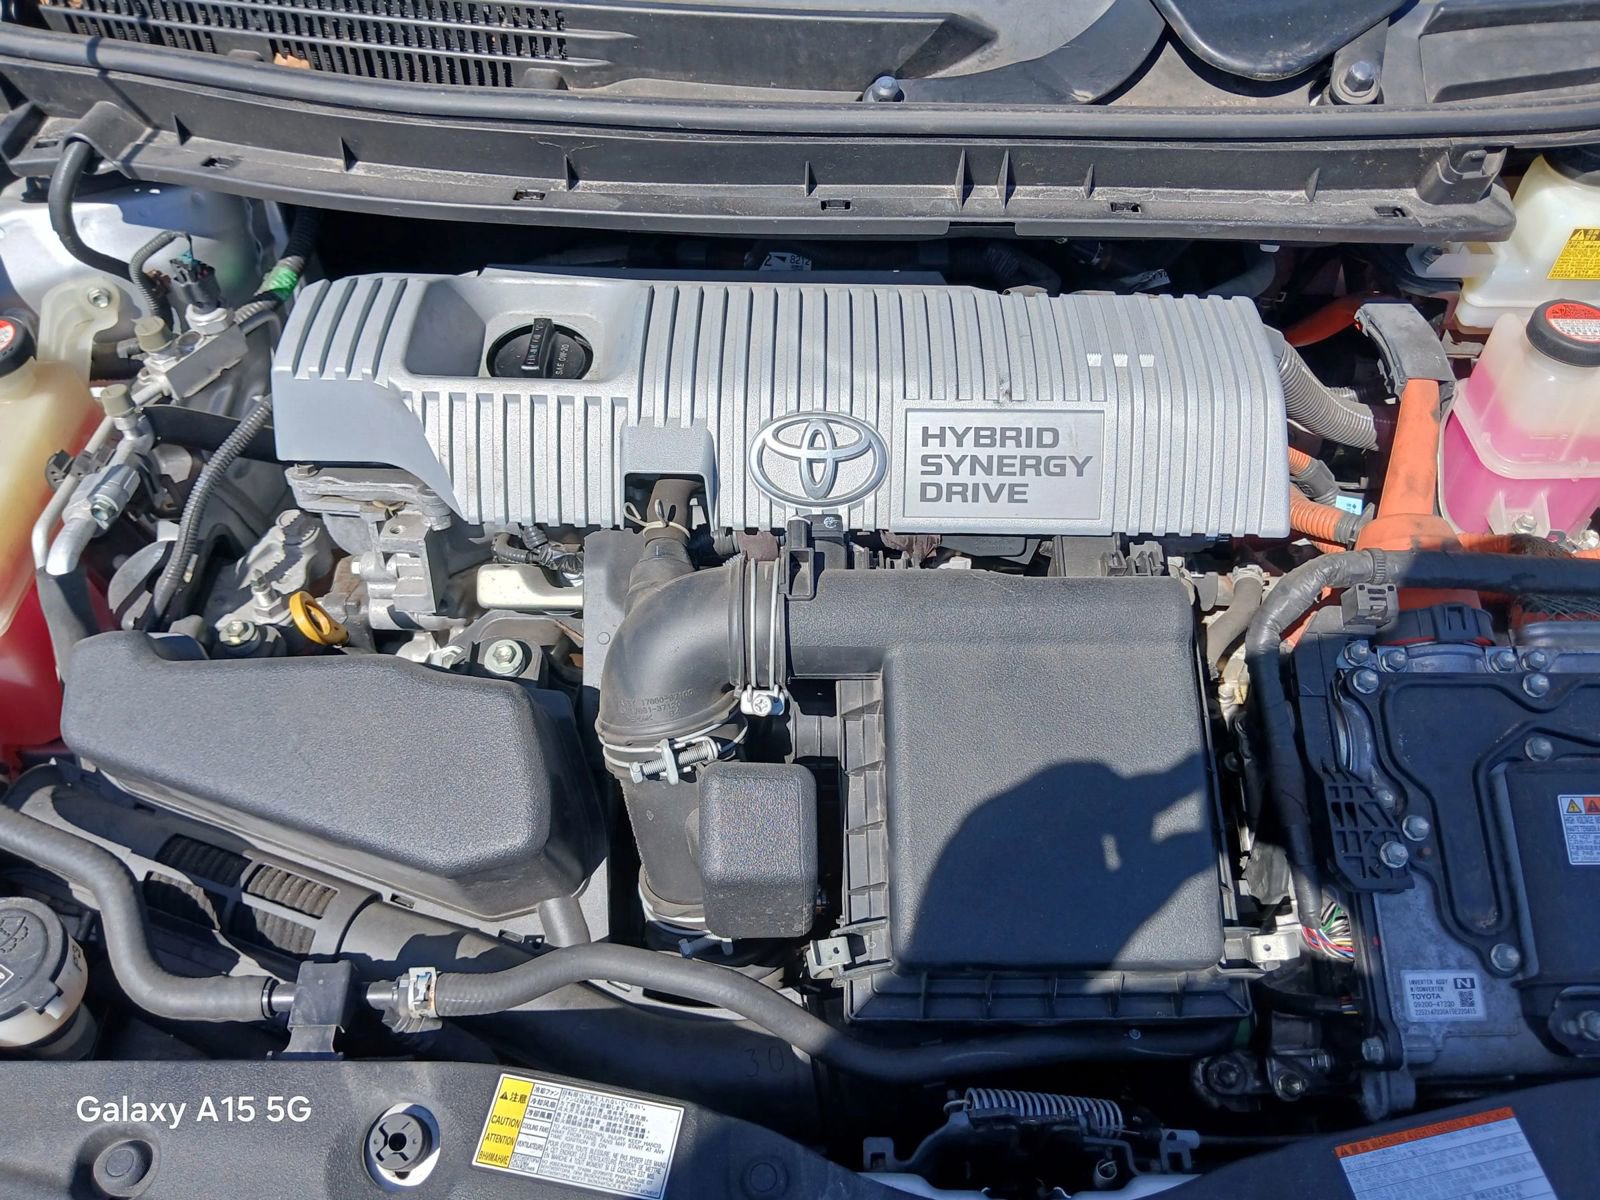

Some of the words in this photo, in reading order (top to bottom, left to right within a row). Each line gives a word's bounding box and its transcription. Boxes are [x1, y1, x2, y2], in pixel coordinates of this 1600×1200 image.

[922, 426, 1060, 449] HYBRID
[920, 454, 1093, 477] SYNERGY
[919, 482, 1029, 504] DRIVE
[491, 1114, 520, 1128] CAUTION
[485, 1132, 515, 1146] ATTENTION
